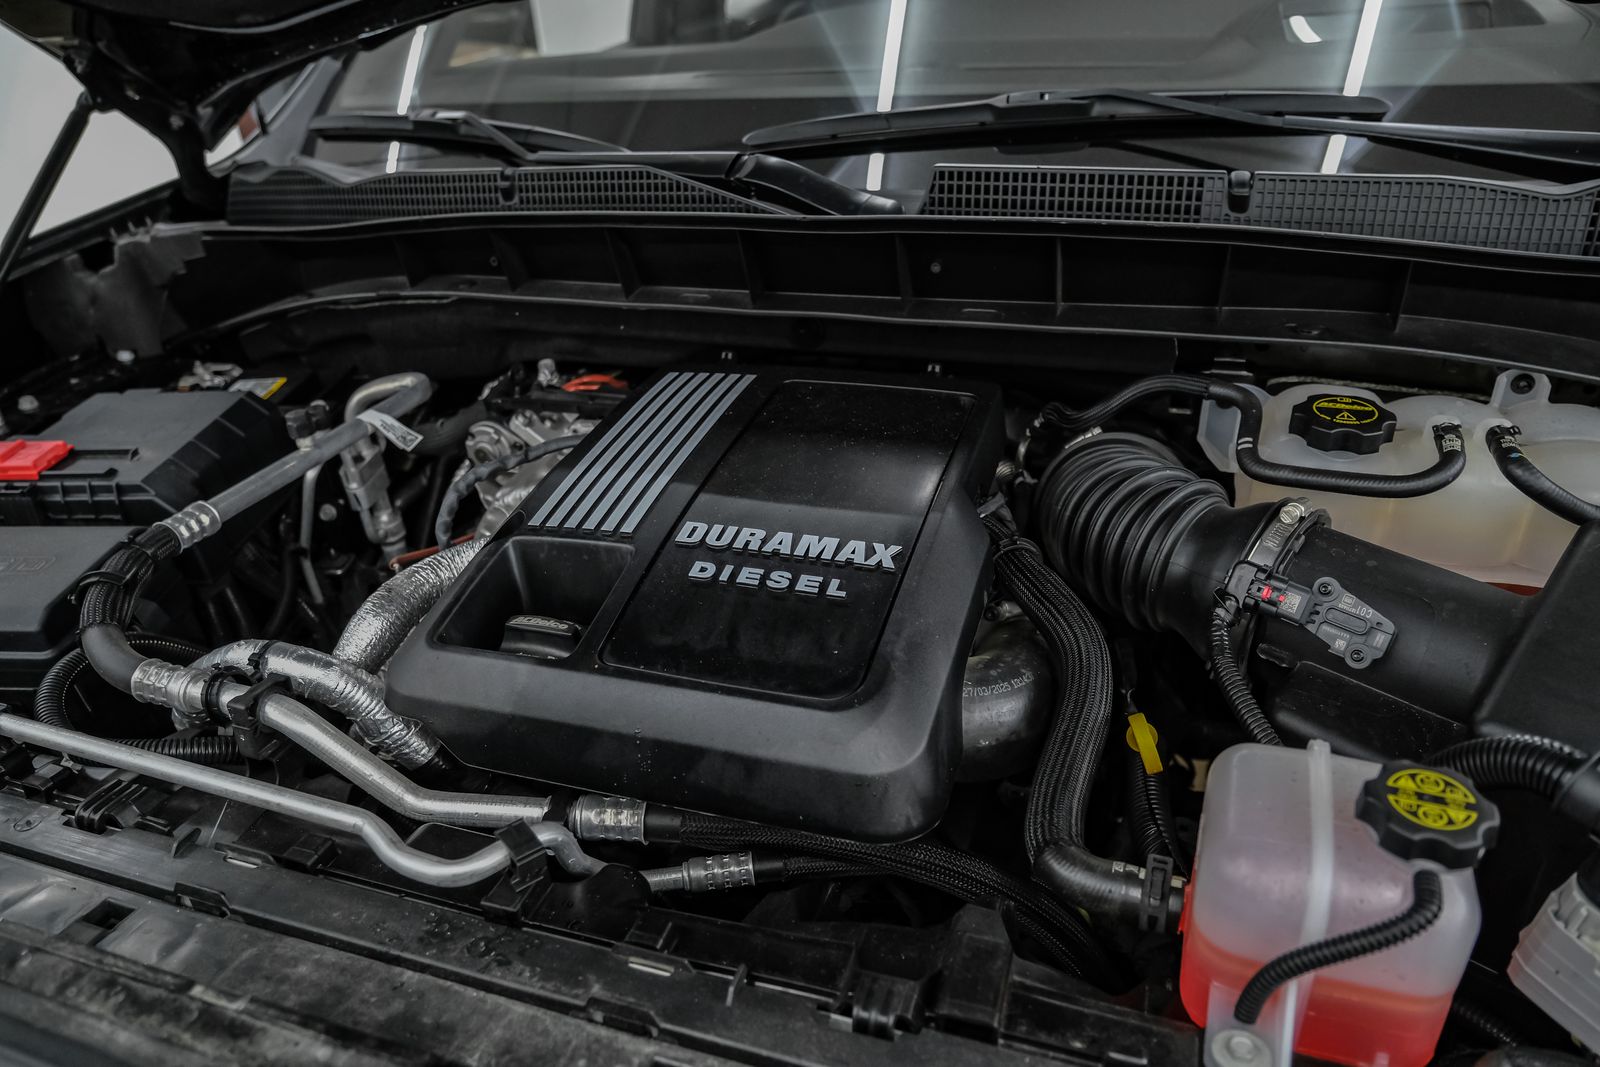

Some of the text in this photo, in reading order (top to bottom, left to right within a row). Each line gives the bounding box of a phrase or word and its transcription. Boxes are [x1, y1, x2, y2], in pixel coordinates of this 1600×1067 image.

[674, 521, 903, 571] DURAMAX
[688, 560, 847, 598] DIESEL
[509, 616, 569, 630] ACDelco
[962, 682, 1011, 697] 27/03/2025
